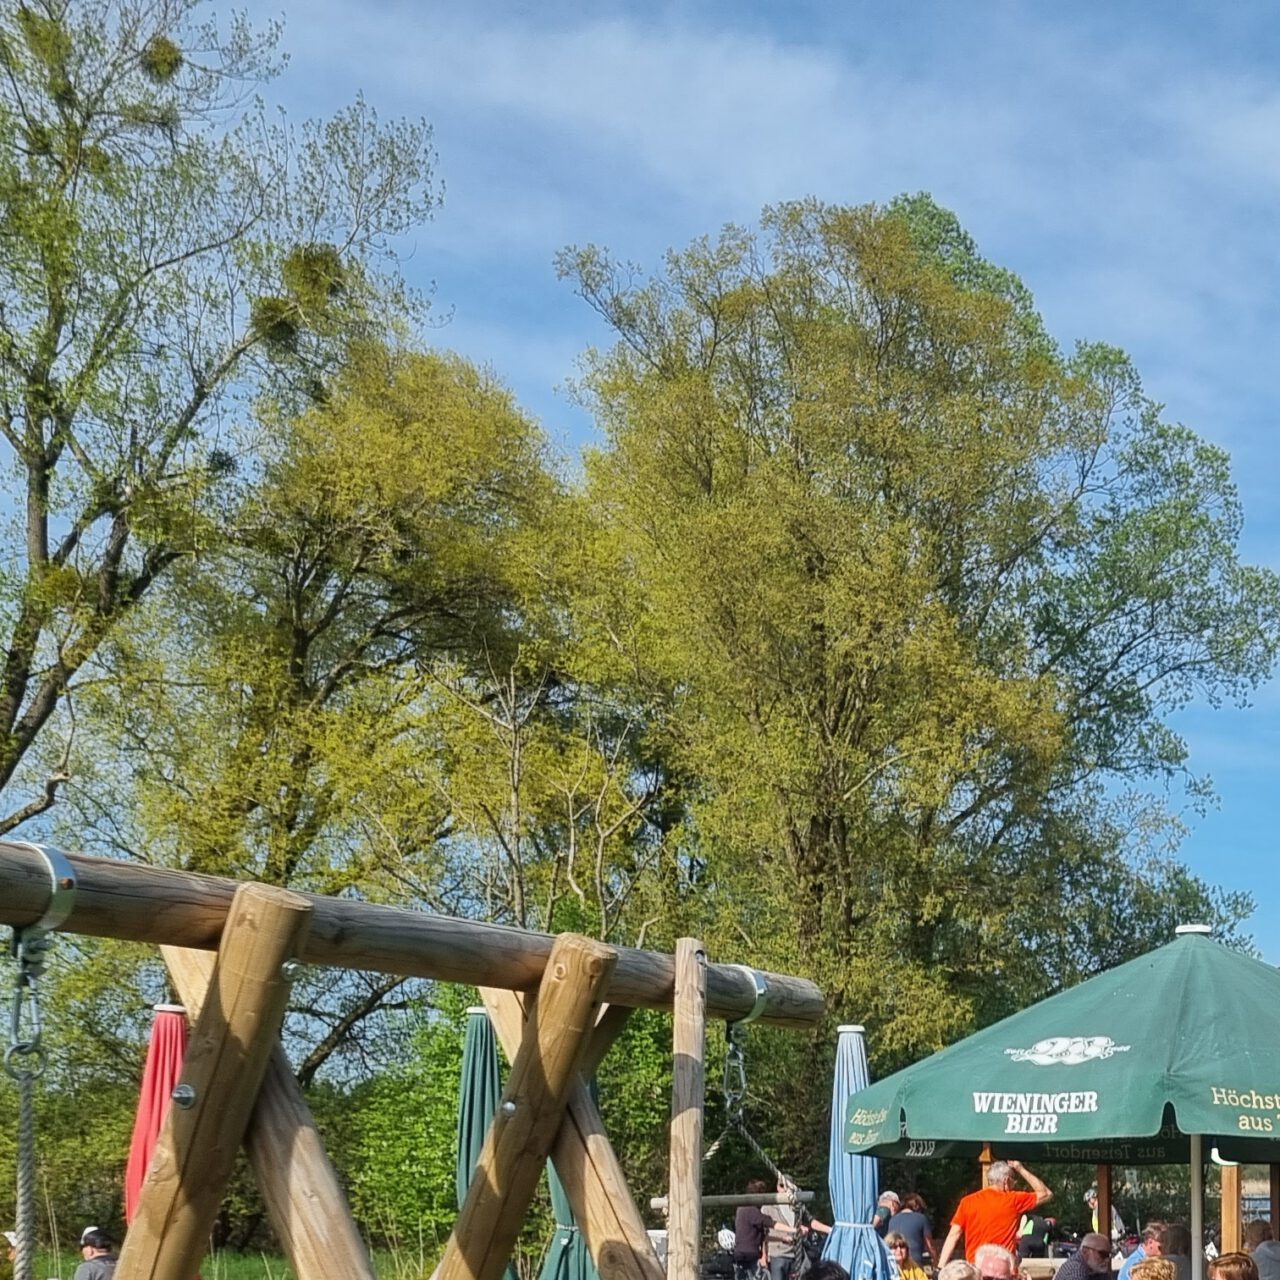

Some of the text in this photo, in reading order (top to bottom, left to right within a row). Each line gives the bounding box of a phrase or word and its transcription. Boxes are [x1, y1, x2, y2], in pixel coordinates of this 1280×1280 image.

[973, 1091, 1098, 1113] WIENINGER
[1005, 1114, 1058, 1133] BIER
[1239, 1115, 1273, 1131] aus
